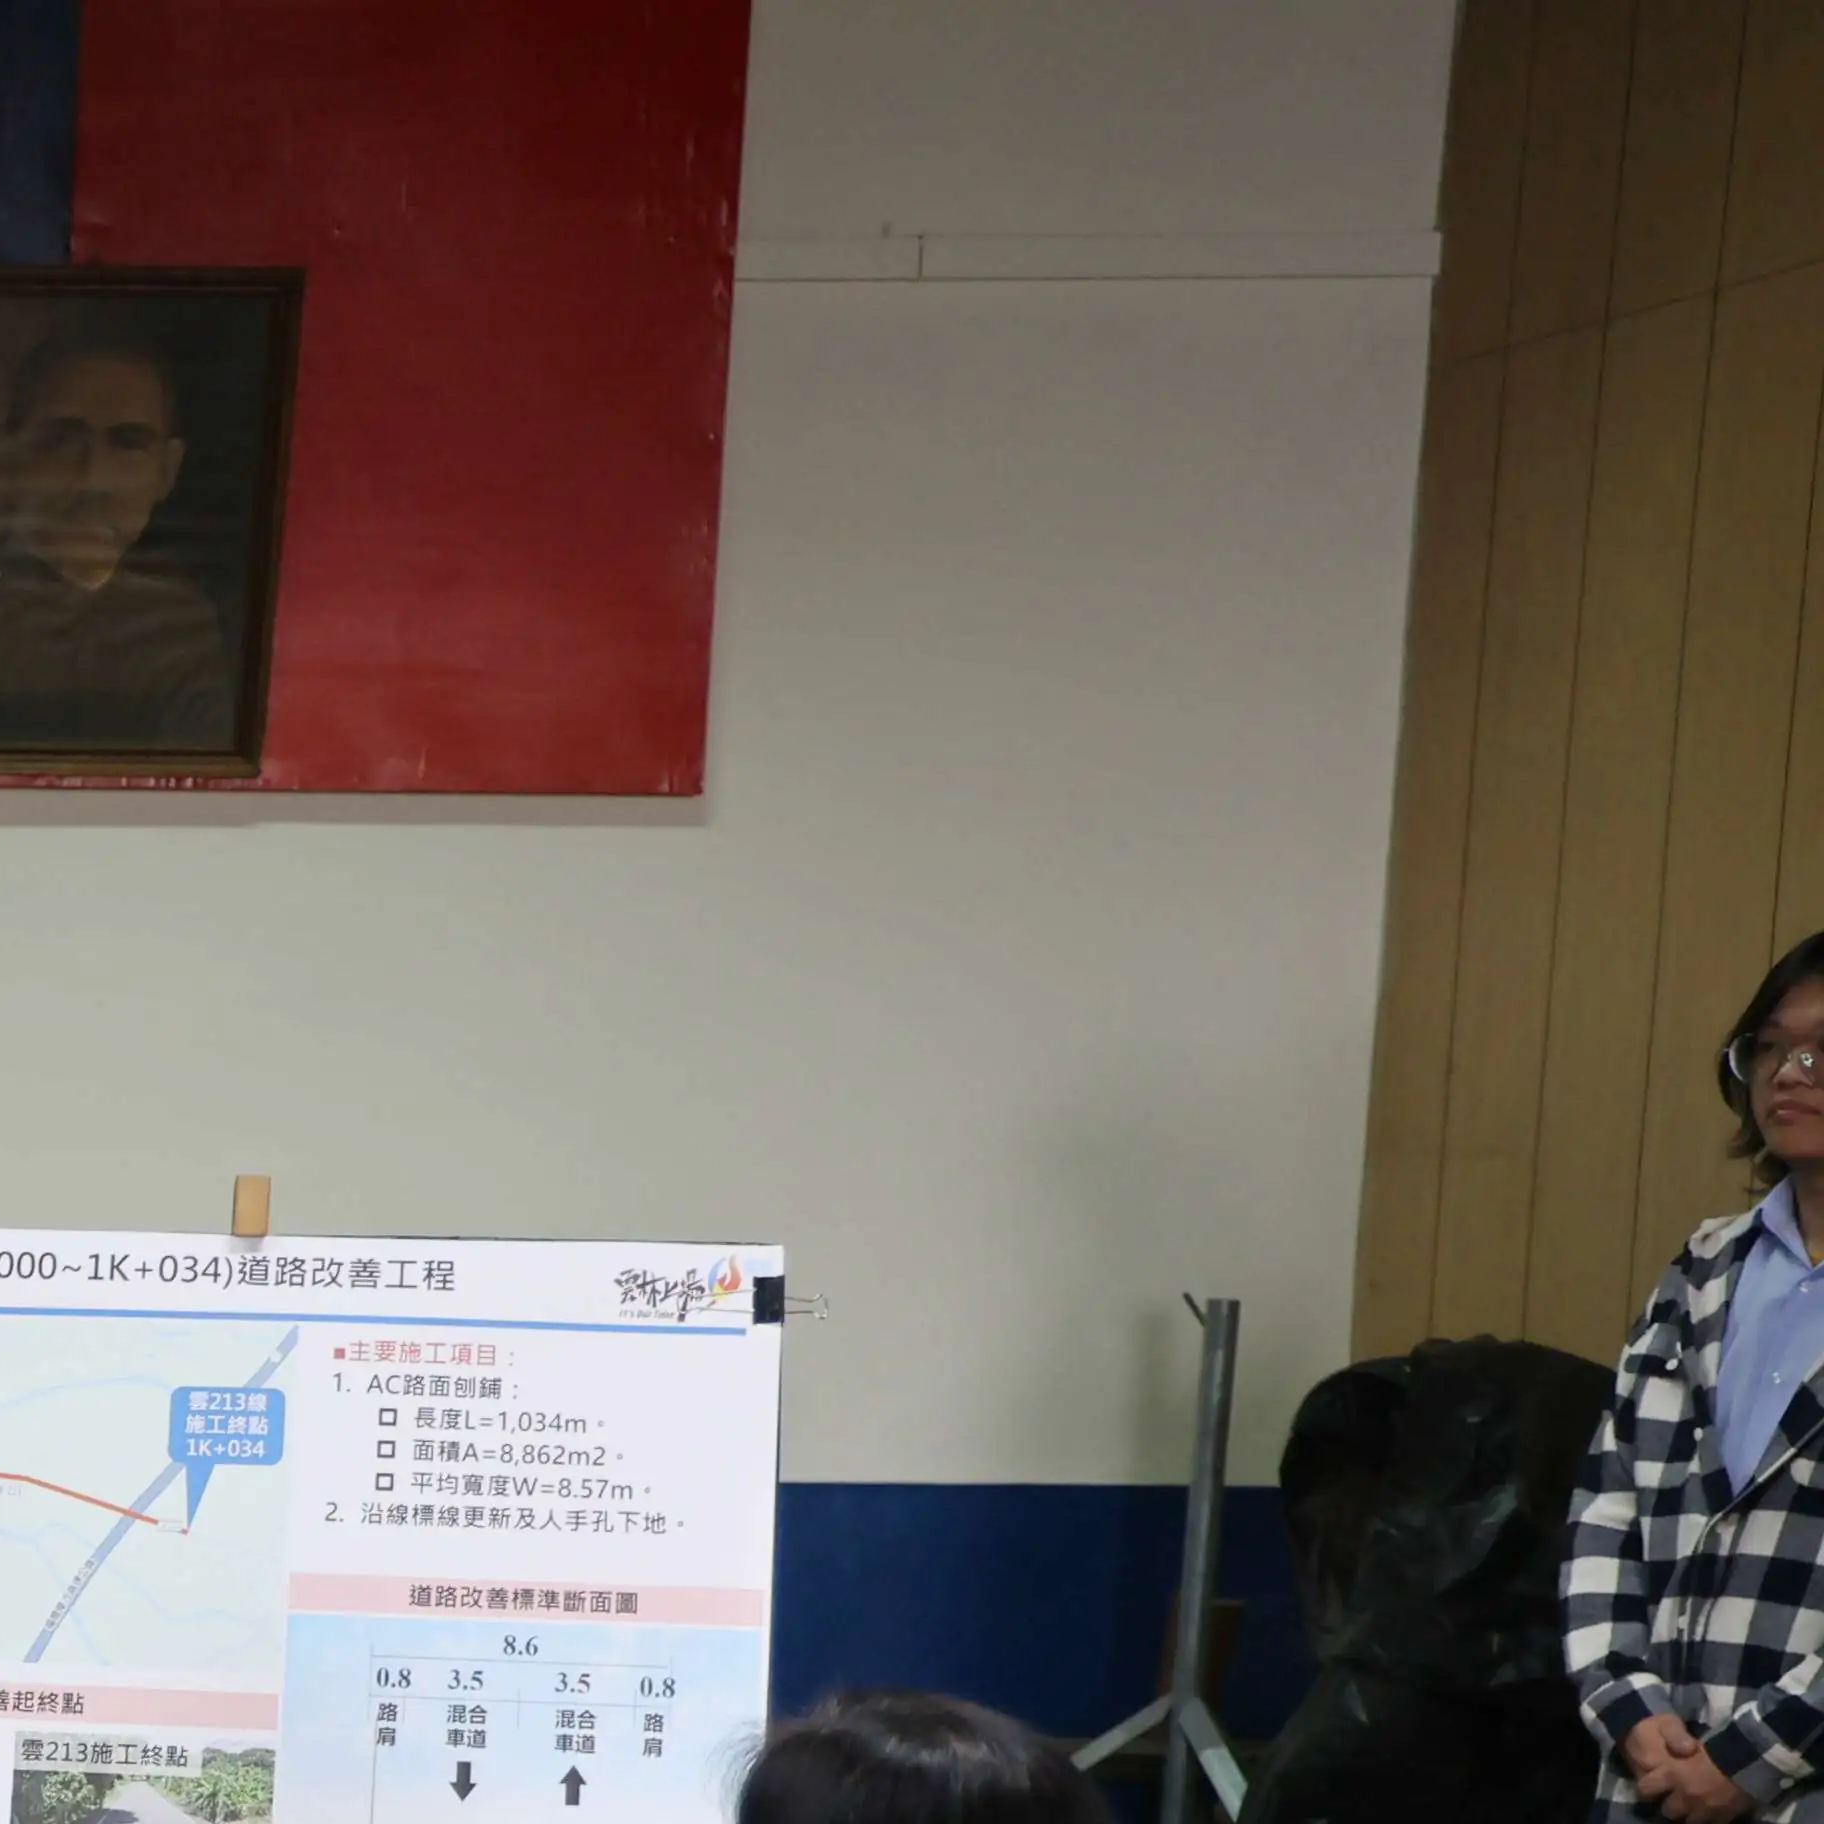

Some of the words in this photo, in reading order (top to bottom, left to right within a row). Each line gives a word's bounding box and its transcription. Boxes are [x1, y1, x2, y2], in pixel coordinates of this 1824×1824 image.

[333, 1373, 351, 1394] 1.
[188, 1391, 267, 1412] 雲213線
[185, 1414, 269, 1436] 施工終點
[186, 1438, 266, 1458] 1K+034
[324, 1502, 345, 1524] 2.
[408, 1584, 639, 1615] 道路改善標準斷面圖
[503, 1634, 539, 1657] 8.6
[376, 1666, 412, 1689] 0.8
[447, 1669, 484, 1691] 3.5
[554, 1672, 591, 1694] 3.5
[639, 1676, 677, 1698] 0.8
[446, 1704, 488, 1726] 混合
[555, 1708, 597, 1730] 混合
[445, 1728, 487, 1749] 車道
[555, 1733, 596, 1754] 車道
[21, 1738, 190, 1768] 雲213施工終點
